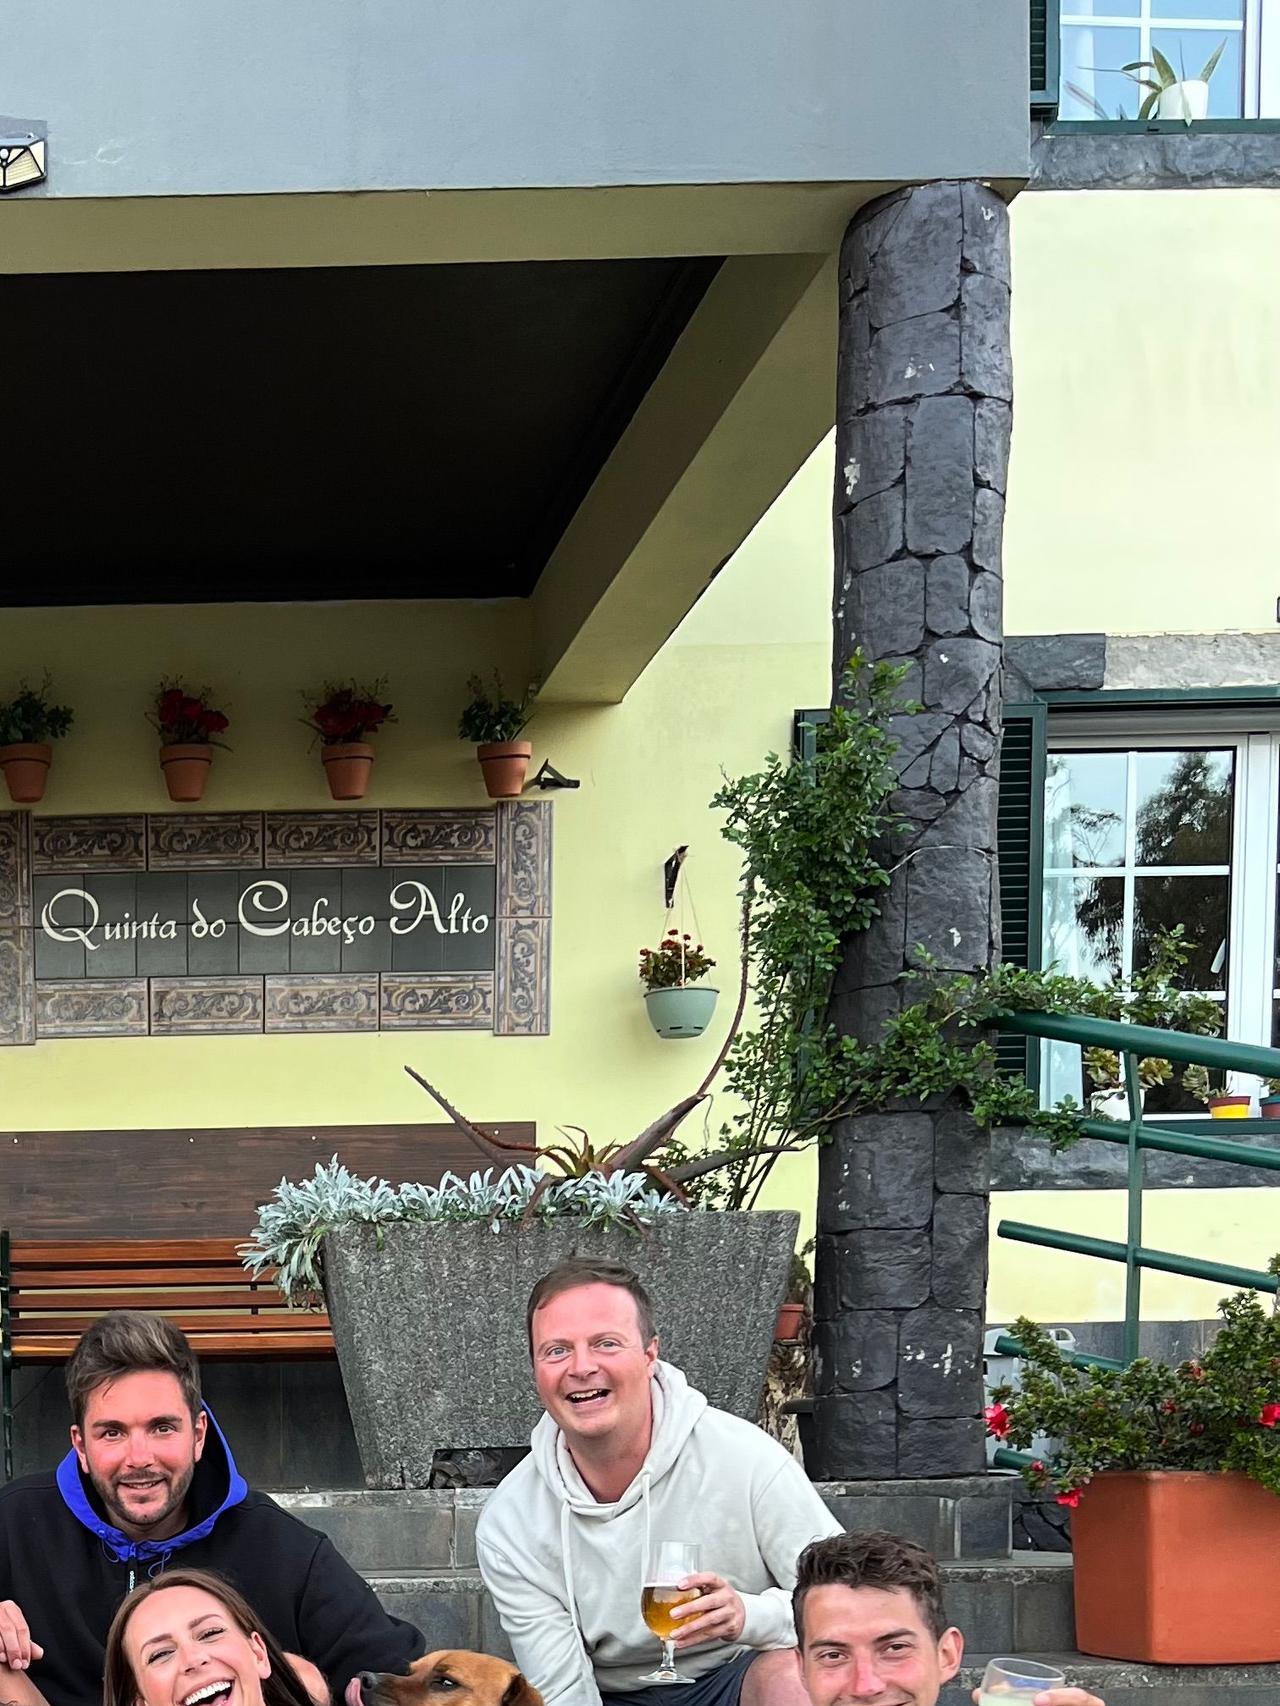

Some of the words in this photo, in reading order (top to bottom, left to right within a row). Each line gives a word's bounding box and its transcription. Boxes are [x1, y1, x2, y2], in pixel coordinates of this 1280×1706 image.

[41, 888, 178, 951] Quinta
[191, 898, 226, 939] do
[238, 880, 375, 944] Cabeço
[389, 880, 490, 936] Alto
